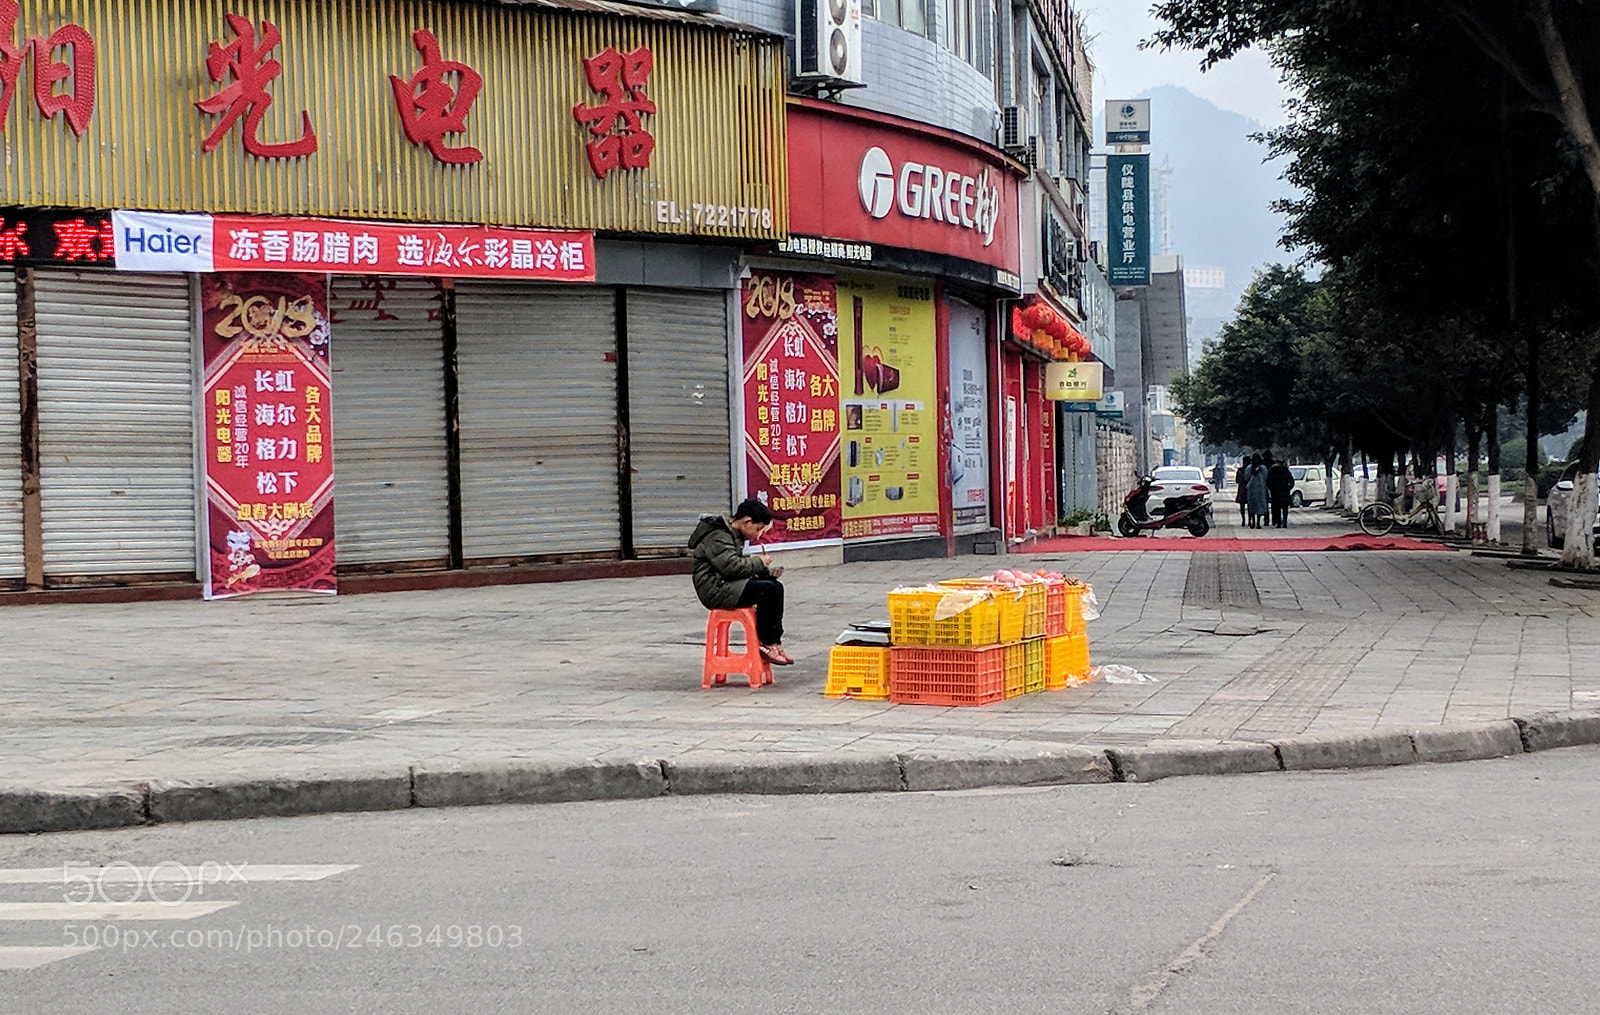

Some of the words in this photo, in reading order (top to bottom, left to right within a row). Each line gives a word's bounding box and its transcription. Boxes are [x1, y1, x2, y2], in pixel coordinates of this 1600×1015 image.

[899, 161, 975, 229] GREE
[125, 227, 201, 254] Haier
[229, 230, 379, 264] 冻香肠腊肉
[397, 232, 585, 270] 选海尔彩晶冷柜
[784, 336, 805, 357] 长虹
[254, 369, 296, 393] 长虹
[784, 368, 806, 390] 海尔
[810, 374, 835, 397] 各大
[255, 403, 297, 427] 海尔
[757, 363, 769, 446] 阳光电器
[785, 401, 807, 423] 格力
[215, 389, 232, 463] 阳光电器
[305, 386, 323, 463] 各大品牌
[811, 409, 836, 432] 品牌
[256, 437, 298, 460] 格力
[786, 434, 807, 456] 松下
[256, 471, 298, 494] 松下
[237, 502, 314, 521] 迎春大酬宾
